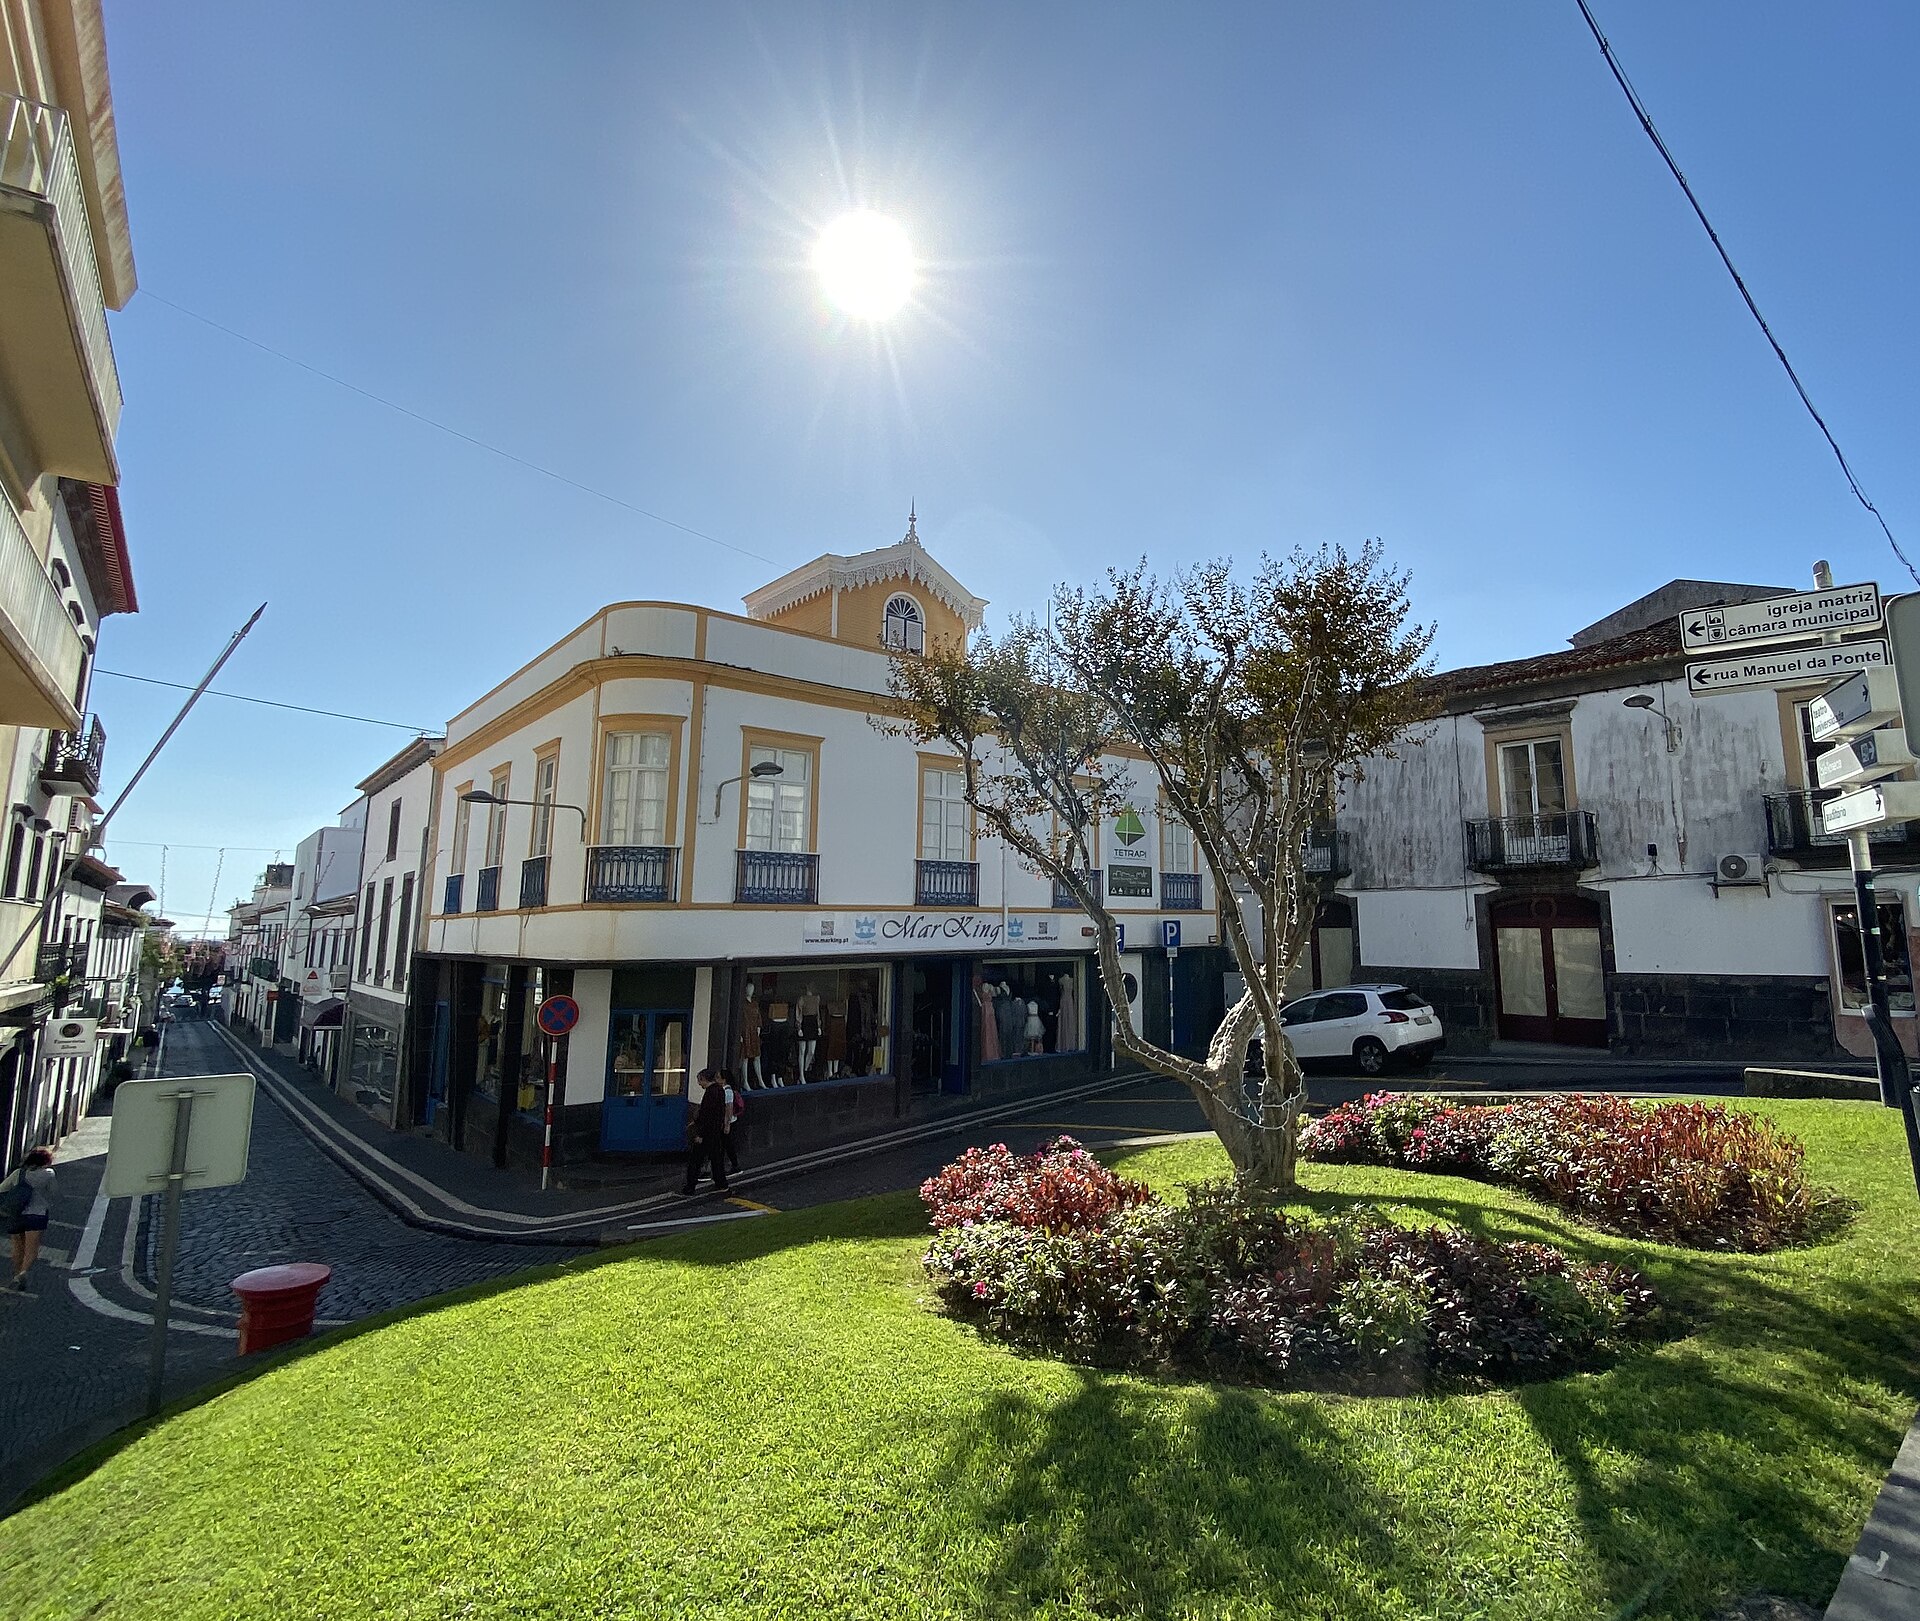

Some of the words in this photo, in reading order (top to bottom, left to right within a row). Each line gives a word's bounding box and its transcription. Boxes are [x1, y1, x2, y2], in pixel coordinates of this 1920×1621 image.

[1767, 600, 1813, 617] igreja
[1818, 590, 1874, 608] matriz
[1728, 620, 1787, 637] câmara
[1792, 605, 1875, 628] municipal
[1713, 669, 1739, 681] rua
[1743, 658, 1801, 677] Manuel
[1806, 657, 1827, 669] da
[1832, 651, 1881, 666] Ponte
[1114, 848, 1147, 858] TETRAPI
[1166, 922, 1177, 945] P
